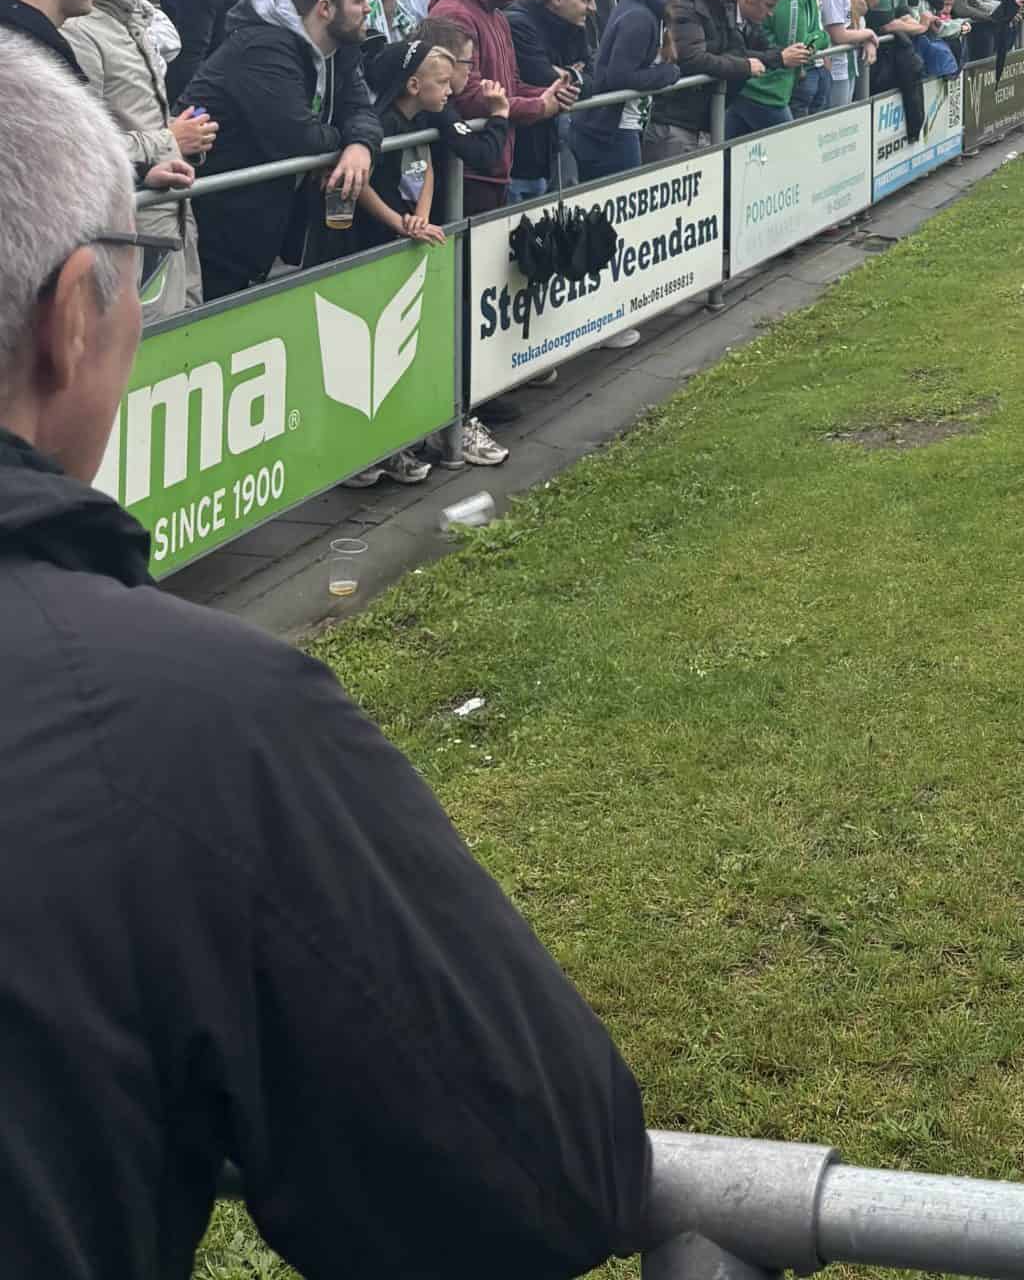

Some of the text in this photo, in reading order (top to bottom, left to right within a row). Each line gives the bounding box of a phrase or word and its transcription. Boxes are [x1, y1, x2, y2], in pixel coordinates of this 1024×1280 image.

[877, 135, 909, 162] spor
[878, 102, 906, 132] Hig
[509, 171, 702, 261] ORSBEDRIJF
[745, 183, 800, 225] PODOLOGIE
[608, 214, 719, 282] Veendam
[511, 303, 626, 369] Stukadoorgroningen.nl
[154, 459, 285, 561] SINCE 1900
